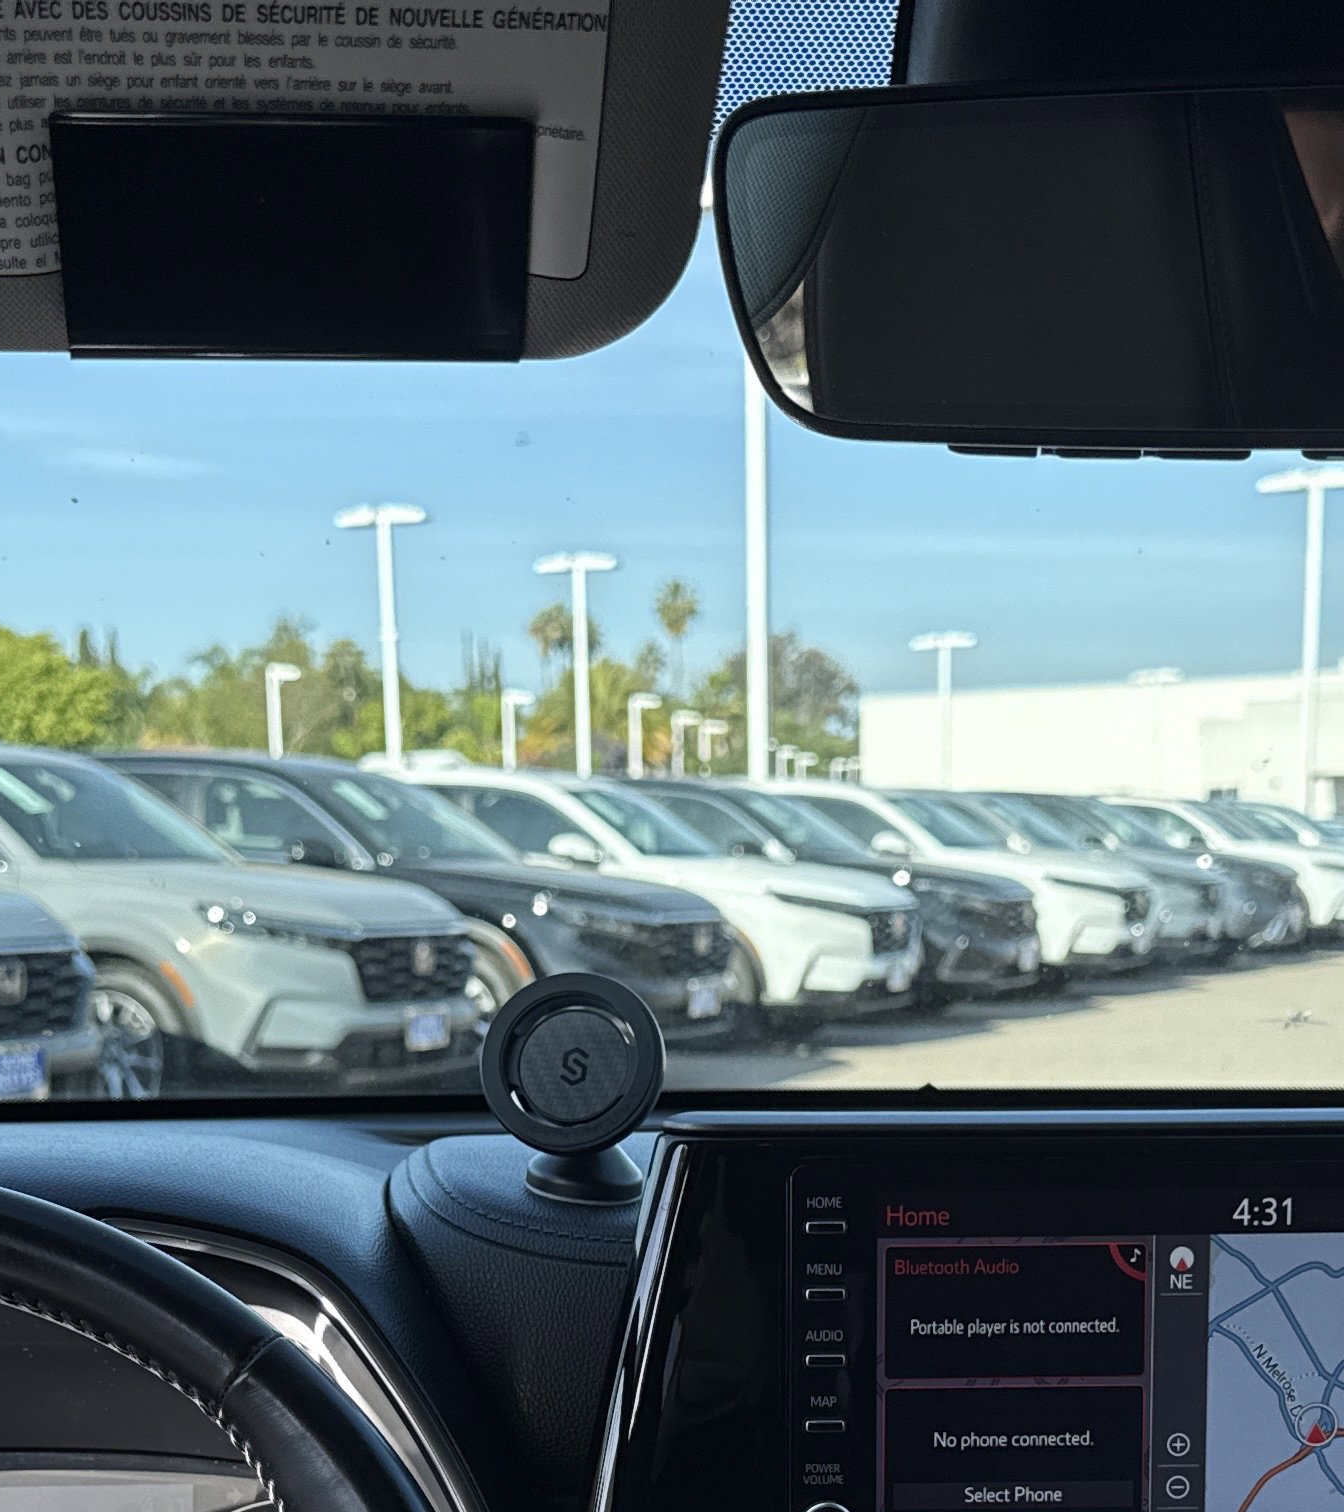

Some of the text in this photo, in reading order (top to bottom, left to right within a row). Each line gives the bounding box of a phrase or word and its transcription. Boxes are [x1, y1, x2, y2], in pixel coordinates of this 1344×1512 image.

[14, 1, 62, 19] AVEC
[72, 1, 109, 20] DES
[119, 2, 212, 23] COUSSINS
[222, 3, 247, 23] DE
[257, 1, 346, 26] SÉCURITÉ
[355, 6, 379, 26] DE
[389, 7, 483, 29] NOUVELLE
[492, 4, 606, 32] GÉNÉRATION
[23, 28, 72, 45] peuvent
[142, 30, 159, 43] ou
[164, 30, 231, 47] gravement
[291, 35, 311, 49] par
[318, 33, 328, 47] le
[334, 35, 382, 48] coussin
[386, 34, 403, 49] de
[53, 52, 73, 65] est
[134, 51, 144, 66] le
[150, 51, 176, 69] plus
[208, 55, 236, 71] pour
[243, 53, 262, 68] les
[19, 73, 59, 89] jamais
[65, 74, 81, 88] un
[126, 75, 154, 91] pour
[160, 72, 198, 89] enfant
[337, 79, 357, 93] sur
[363, 78, 374, 92] le
[9, 118, 34, 135] plus
[6, 172, 31, 190] bag
[15, 211, 56, 229] coloqu
[30, 232, 60, 248] utilic
[36, 257, 46, 269] el
[807, 1196, 842, 1210] HOME
[1231, 1197, 1294, 1227] 4:31
[885, 1204, 950, 1227] Home
[807, 1263, 842, 1276] MENU
[894, 1258, 1020, 1276] Bluetooth Audio
[1169, 1274, 1193, 1290] NE
[806, 1329, 844, 1342] AUDIO
[910, 1317, 1121, 1338] Portable player is not connected.
[1252, 1343, 1268, 1358] N
[1261, 1355, 1297, 1402] Melrose
[810, 1395, 838, 1408] MAP
[933, 1430, 1095, 1450] No phone connected.
[805, 1463, 841, 1475] POWER
[803, 1474, 845, 1485] VOLUME
[964, 1486, 1063, 1503] Select Phone
